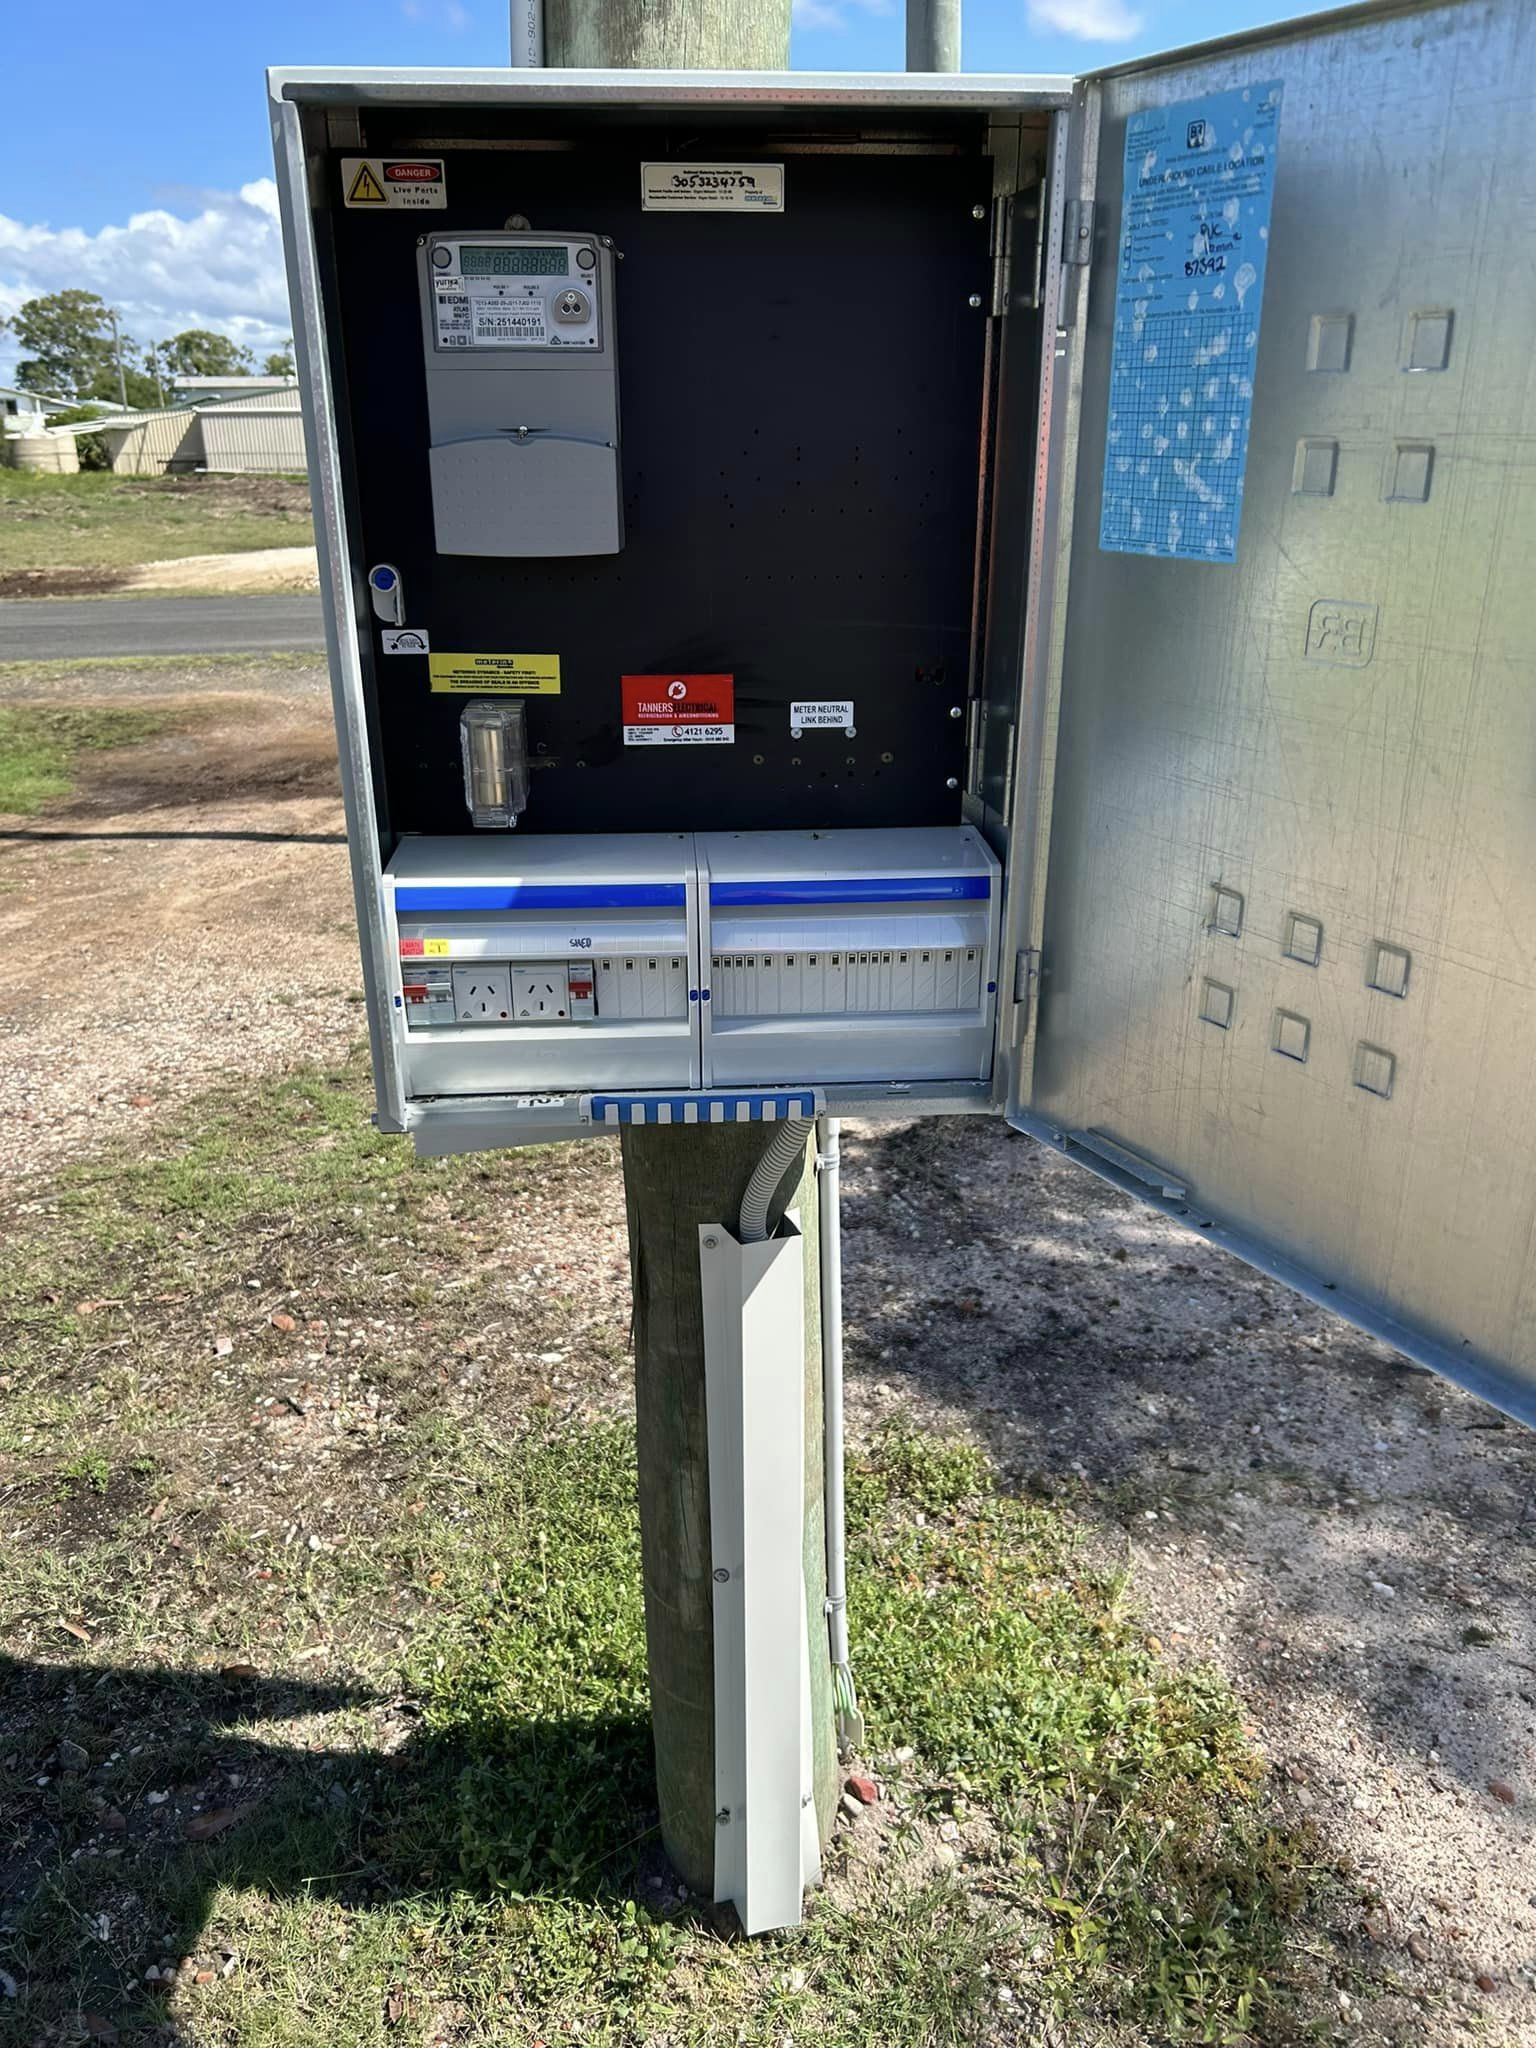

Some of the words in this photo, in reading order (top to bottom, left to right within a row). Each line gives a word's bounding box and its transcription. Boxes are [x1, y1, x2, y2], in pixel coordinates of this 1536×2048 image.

[395, 169, 431, 177] DANGER
[447, 296, 469, 305] EDMI
[637, 702, 673, 713] TANNERS
[793, 705, 816, 713] METER
[818, 705, 848, 713] NEUTRAL
[801, 716, 816, 724] LINK
[818, 715, 843, 723] BEHIND
[705, 727, 723, 735] 6295
[569, 937, 592, 949] SHED
